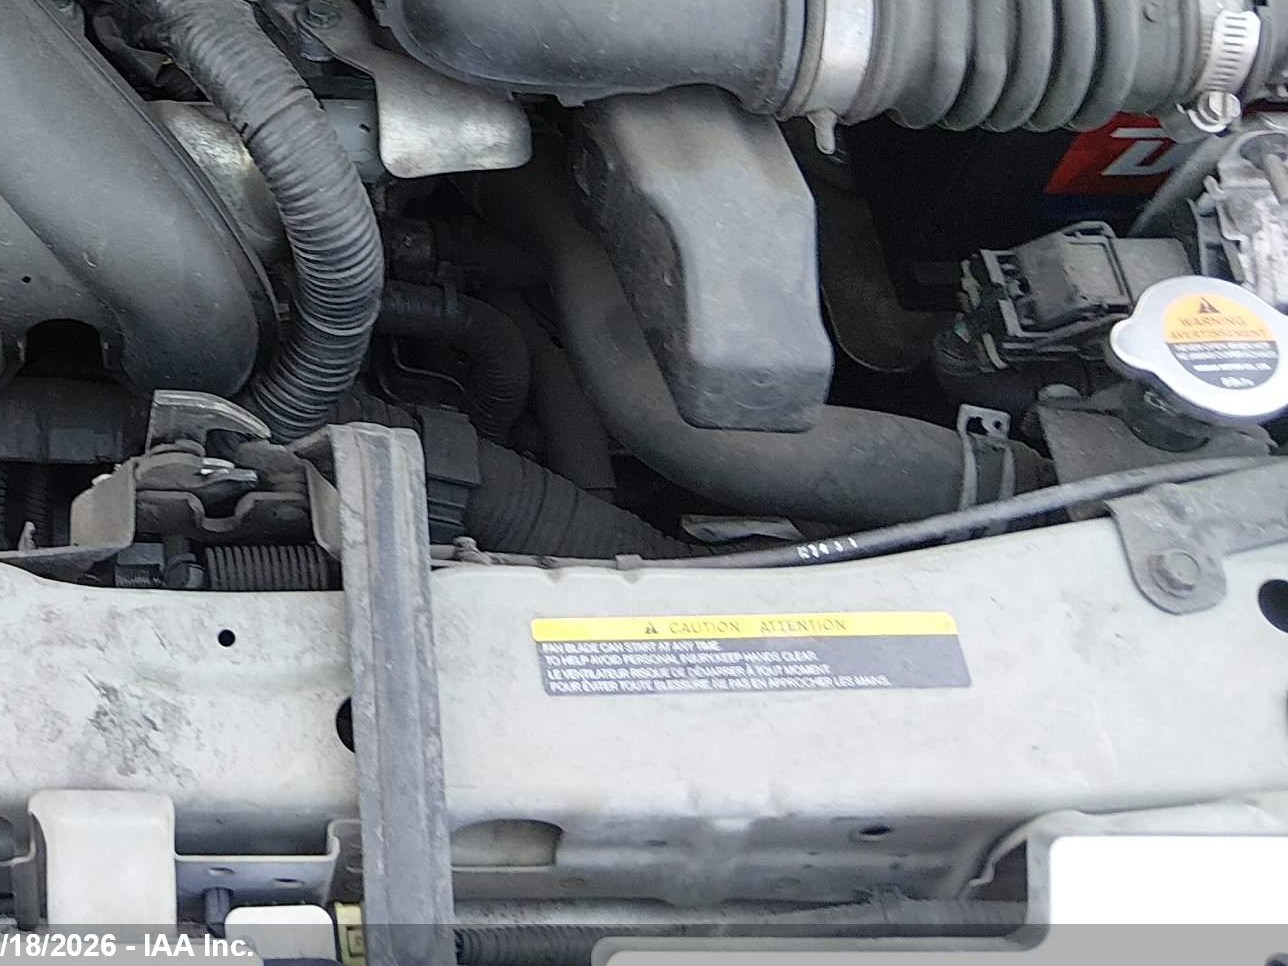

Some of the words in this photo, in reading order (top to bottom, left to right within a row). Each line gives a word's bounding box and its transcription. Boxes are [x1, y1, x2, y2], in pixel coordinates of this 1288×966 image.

[1177, 315, 1248, 327] WARNING
[669, 621, 742, 634] CAUTION
[760, 618, 848, 634] ATTENTION
[541, 642, 563, 654] FAN
[563, 642, 601, 653] BLADE
[599, 642, 626, 652] CAN
[622, 641, 658, 652] START
[656, 641, 672, 652] AT
[671, 641, 695, 652] ANY
[545, 655, 562, 666] TO
[562, 654, 590, 666] HELP
[588, 654, 623, 666] AVOID
[622, 653, 679, 665] PERSONAL
[713, 652, 743, 663] KEEP
[743, 651, 782, 663] HANDS
[546, 668, 562, 680] LE
[629, 667, 671, 679] RISQUE
[670, 667, 688, 678] DE
[754, 664, 784, 676] TOUT
[549, 681, 583, 692] POUR
[727, 677, 752, 689] PAS
[751, 677, 769, 689] EN
[833, 676, 856, 688] LES
